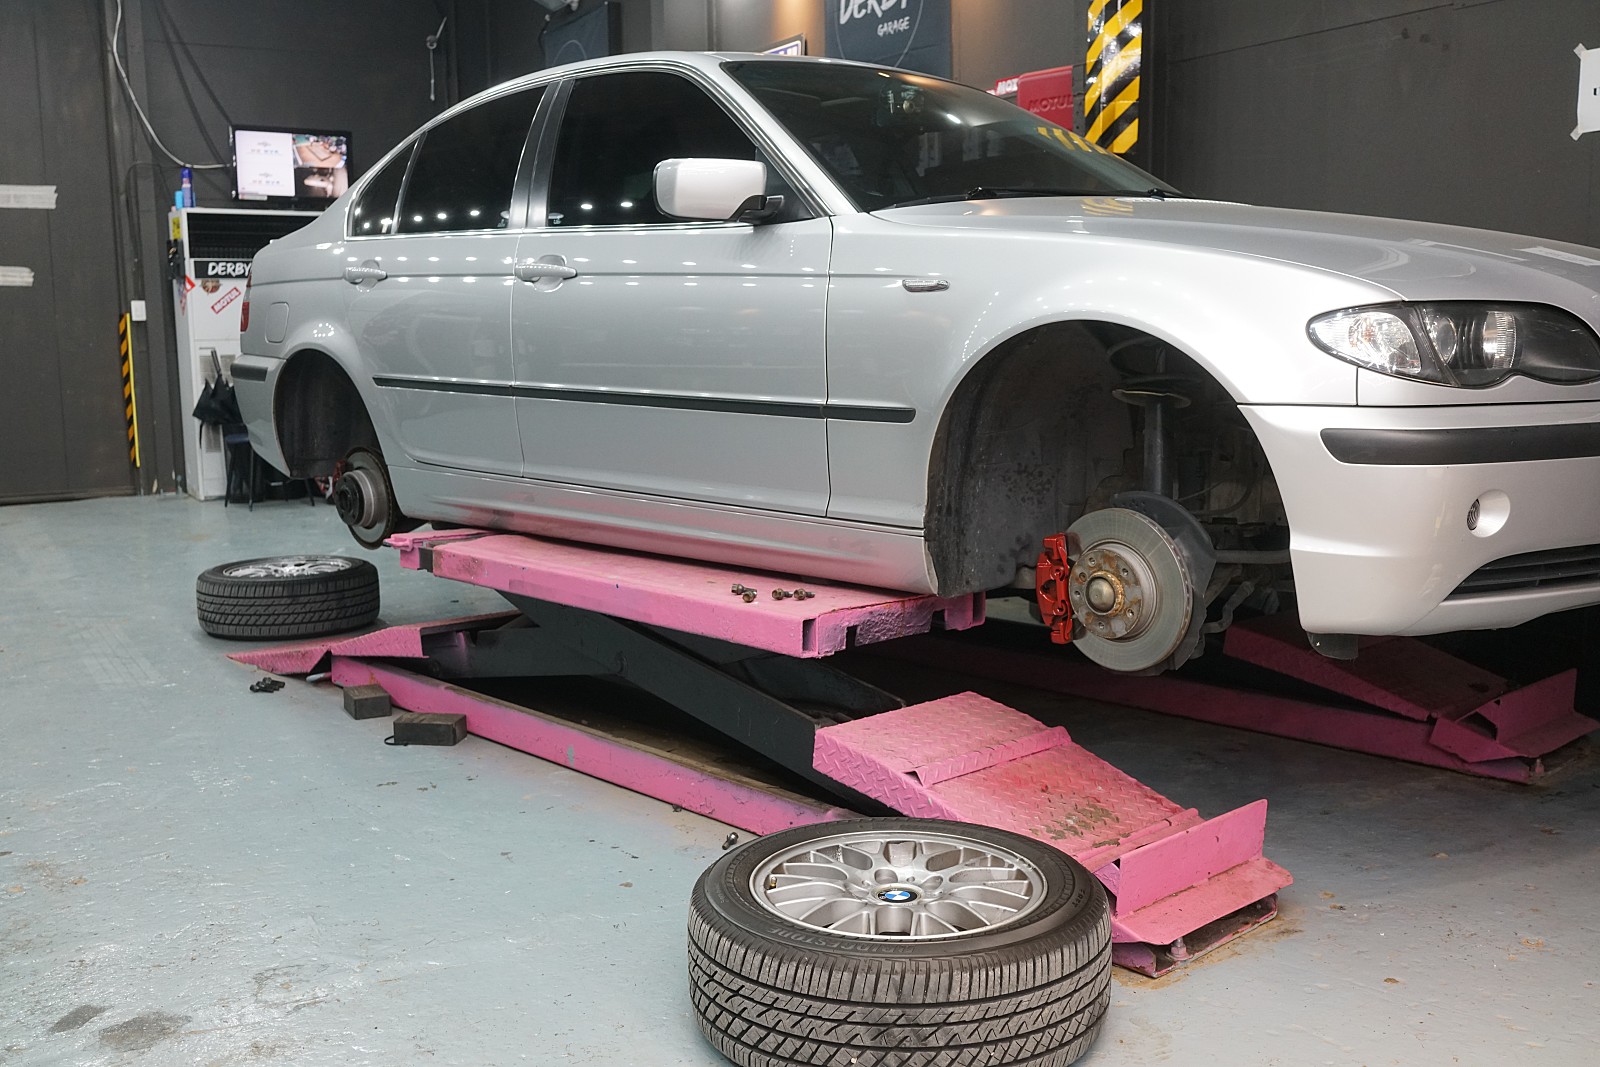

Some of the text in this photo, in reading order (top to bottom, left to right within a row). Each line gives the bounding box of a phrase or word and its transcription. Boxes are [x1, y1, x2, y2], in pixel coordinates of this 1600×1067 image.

[877, 16, 910, 37] GARAGE
[1028, 94, 1074, 113] MOTUL
[207, 261, 251, 277] DERBY
[767, 927, 915, 953] BRIDGESTONE
